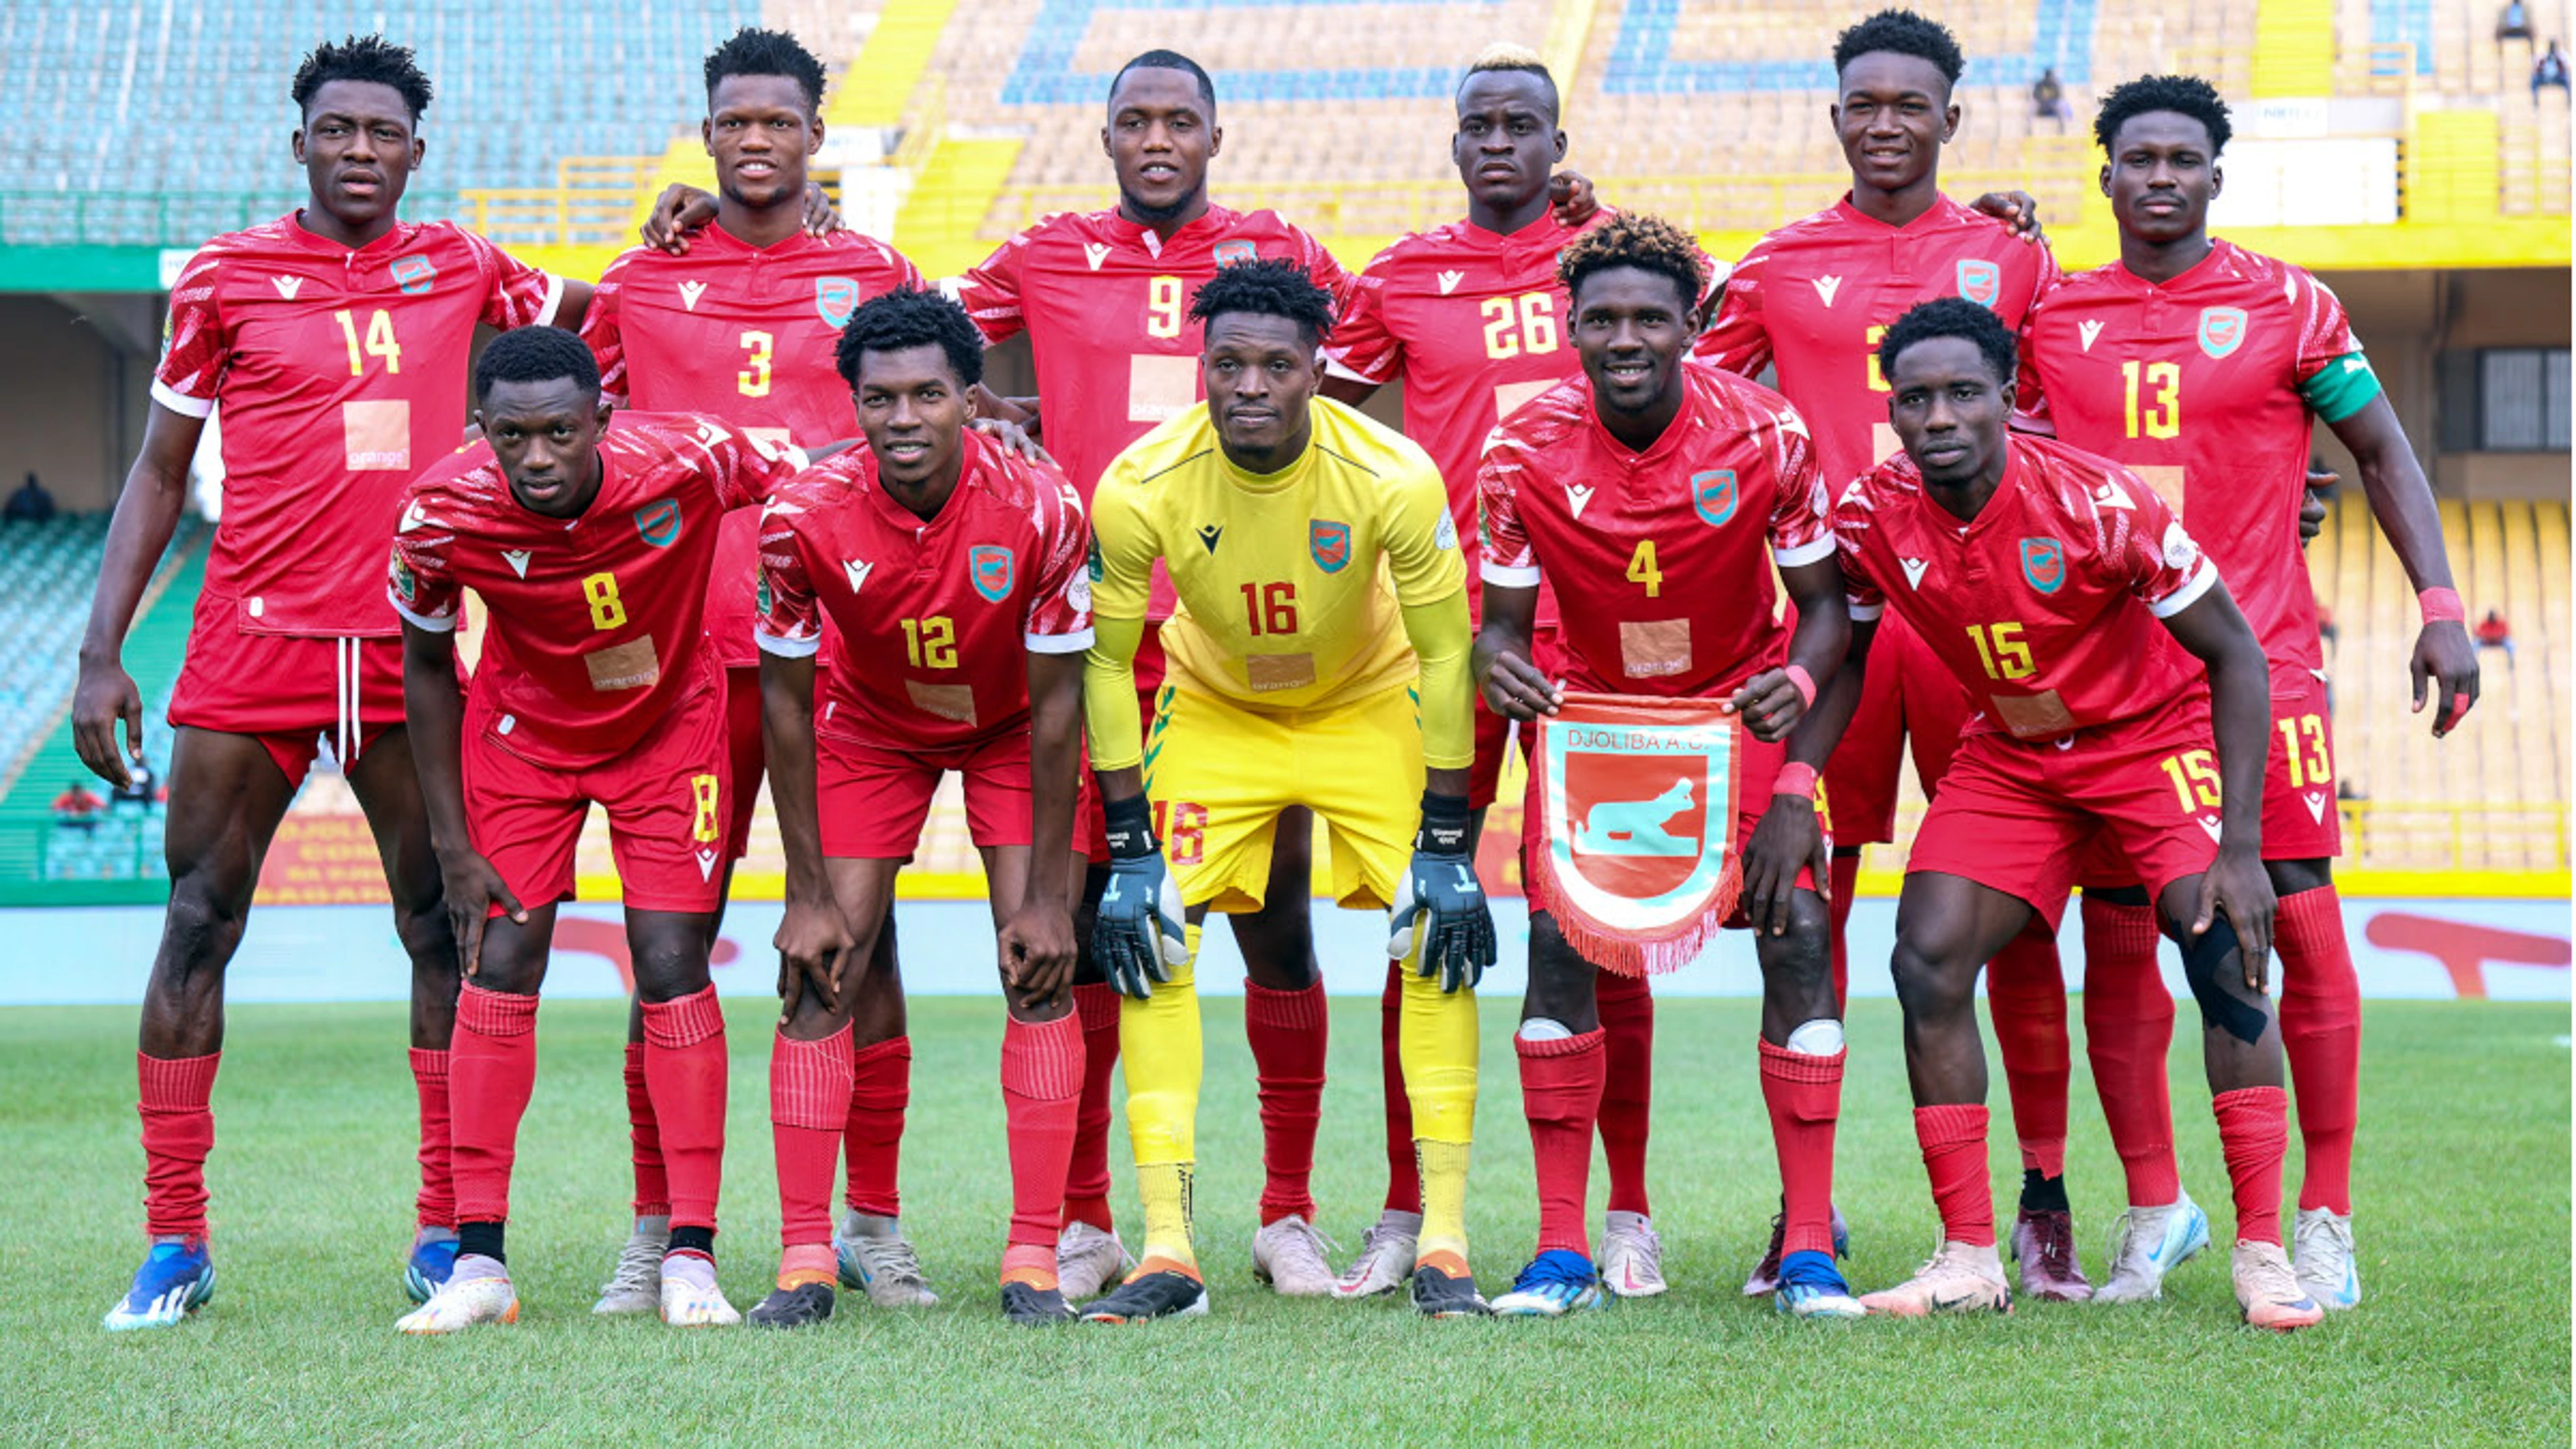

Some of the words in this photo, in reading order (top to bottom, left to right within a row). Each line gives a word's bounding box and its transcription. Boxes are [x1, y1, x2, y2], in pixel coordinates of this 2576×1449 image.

[1148, 275, 1183, 338] 9
[1481, 291, 1558, 360] 26
[335, 309, 401, 376] 14
[739, 330, 773, 397] 3
[2123, 360, 2180, 439] 13
[348, 451, 404, 467] orange
[1625, 539, 1663, 597] 4
[582, 572, 627, 630] 8
[1240, 581, 1297, 636] 16
[900, 616, 958, 669] 12
[1966, 621, 2037, 680] 15
[1568, 729, 1660, 750] DJOLIBA
[1665, 733, 1709, 751] A.C.
[2278, 714, 2331, 788] 13
[691, 773, 719, 842] 8
[2160, 749, 2222, 814] 15
[1153, 800, 1208, 865] 16
